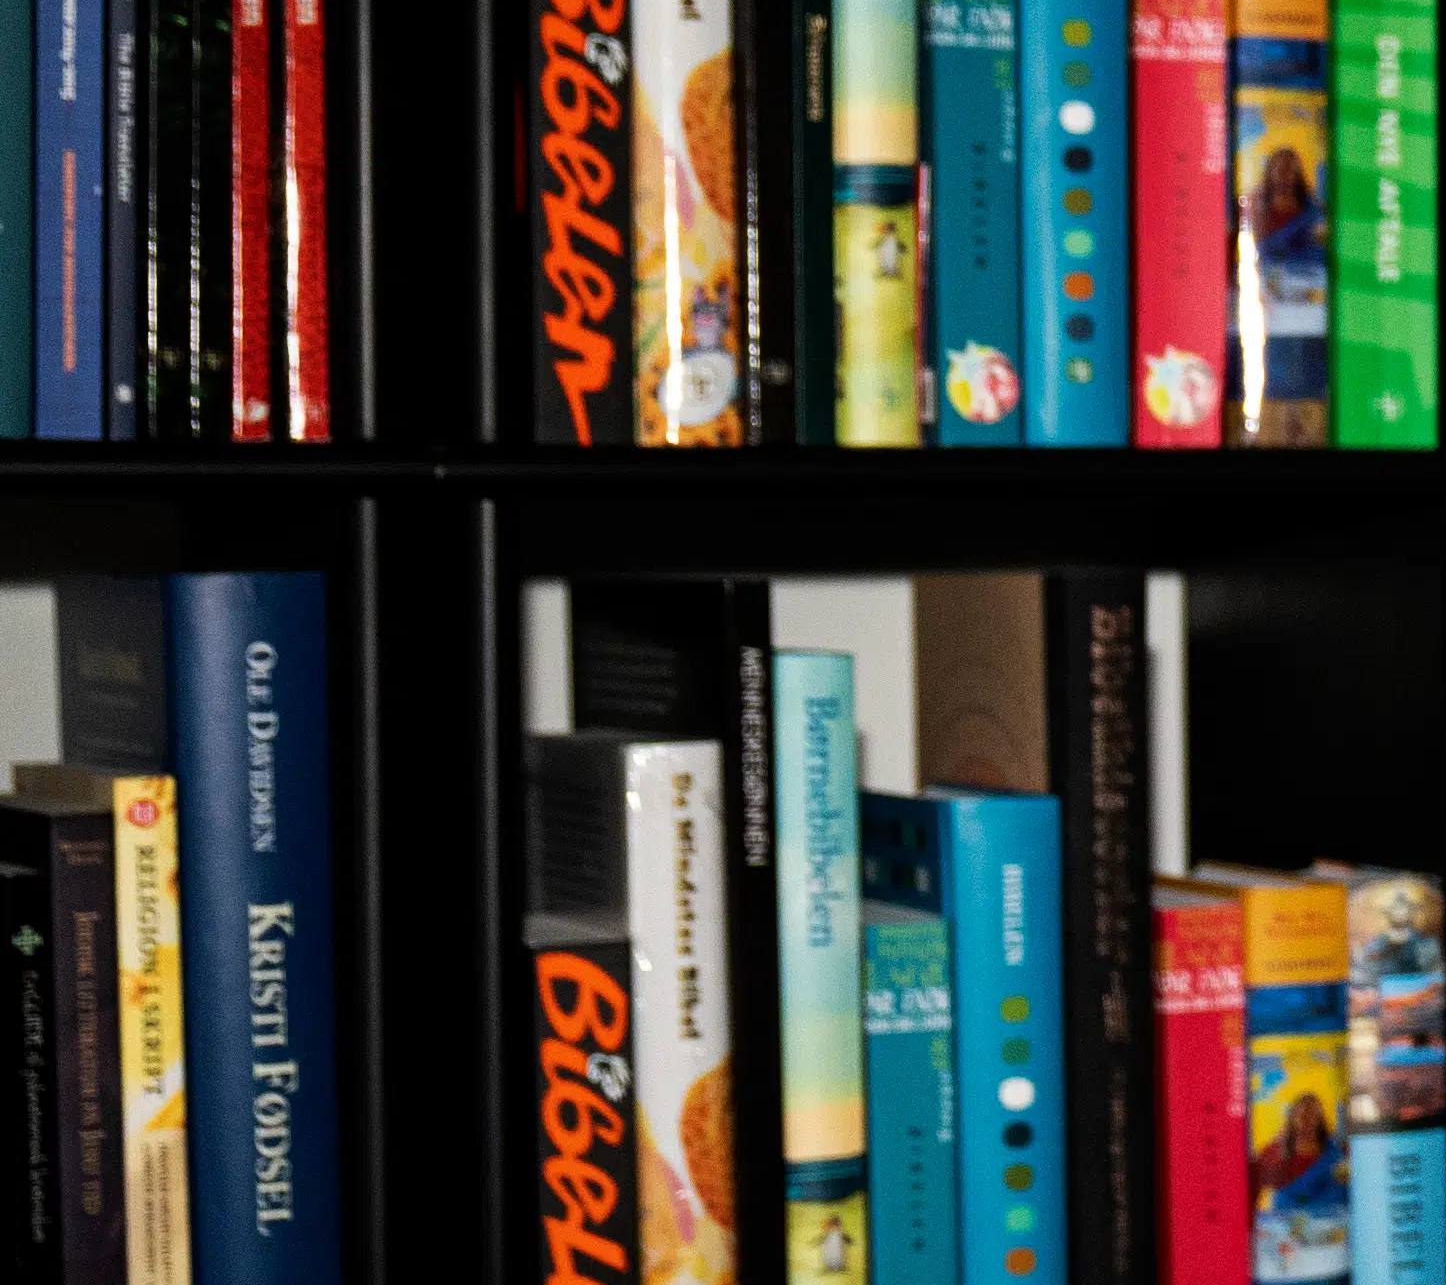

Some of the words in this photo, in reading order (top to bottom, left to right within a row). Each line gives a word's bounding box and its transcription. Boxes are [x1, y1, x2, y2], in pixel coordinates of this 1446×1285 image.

[244, 640, 279, 704] OLE
[803, 696, 842, 949] Børnebibelen
[134, 844, 160, 975] RELIGION
[246, 899, 297, 1047] KRISTI
[1387, 951, 1430, 1149] BIBELEN
[252, 1058, 301, 1237] FØDSEL
